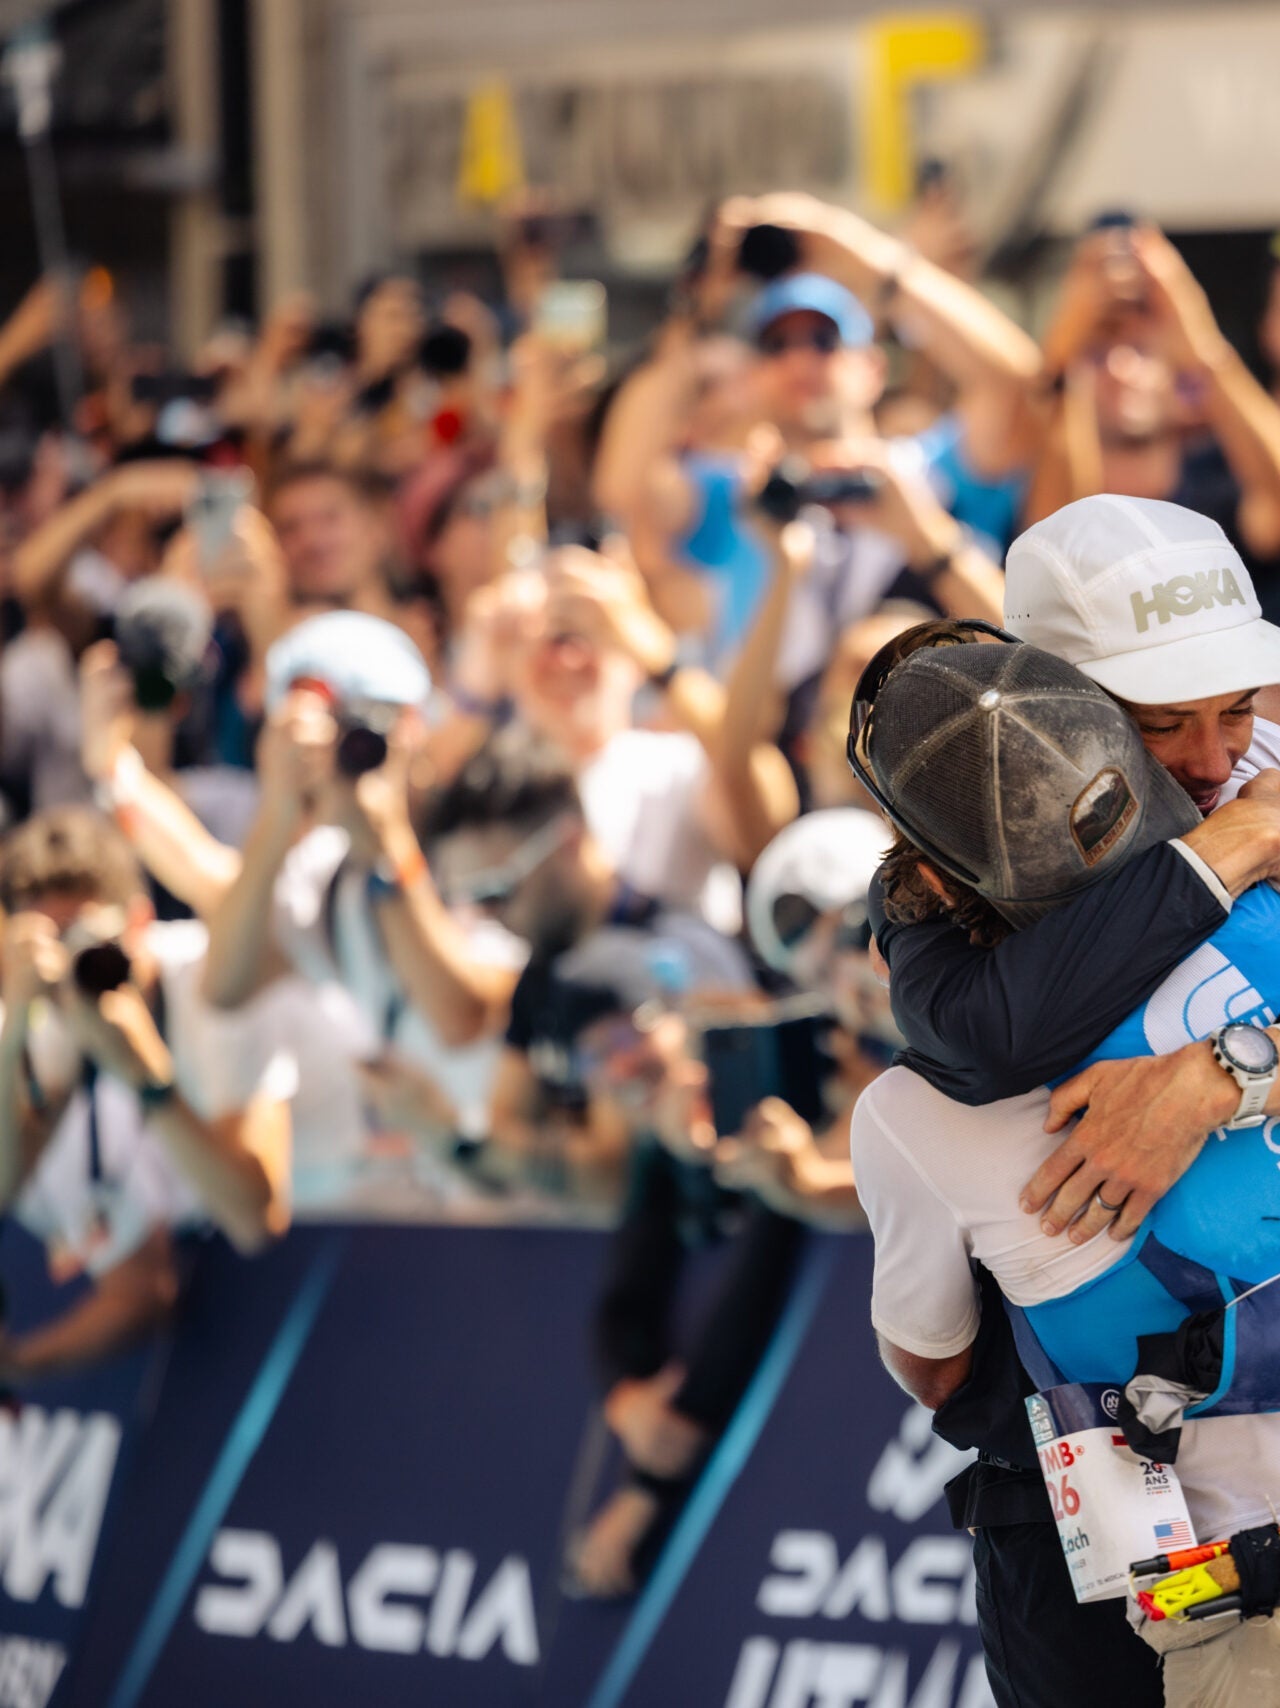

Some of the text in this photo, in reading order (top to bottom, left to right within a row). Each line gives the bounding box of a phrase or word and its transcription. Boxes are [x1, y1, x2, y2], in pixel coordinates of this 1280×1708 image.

[1130, 568, 1246, 633] HOKA
[1046, 1474, 1080, 1521] 26
[1145, 1474, 1169, 1486] ANS
[194, 1527, 540, 1666] DACIA
[756, 1528, 978, 1625] DAC
